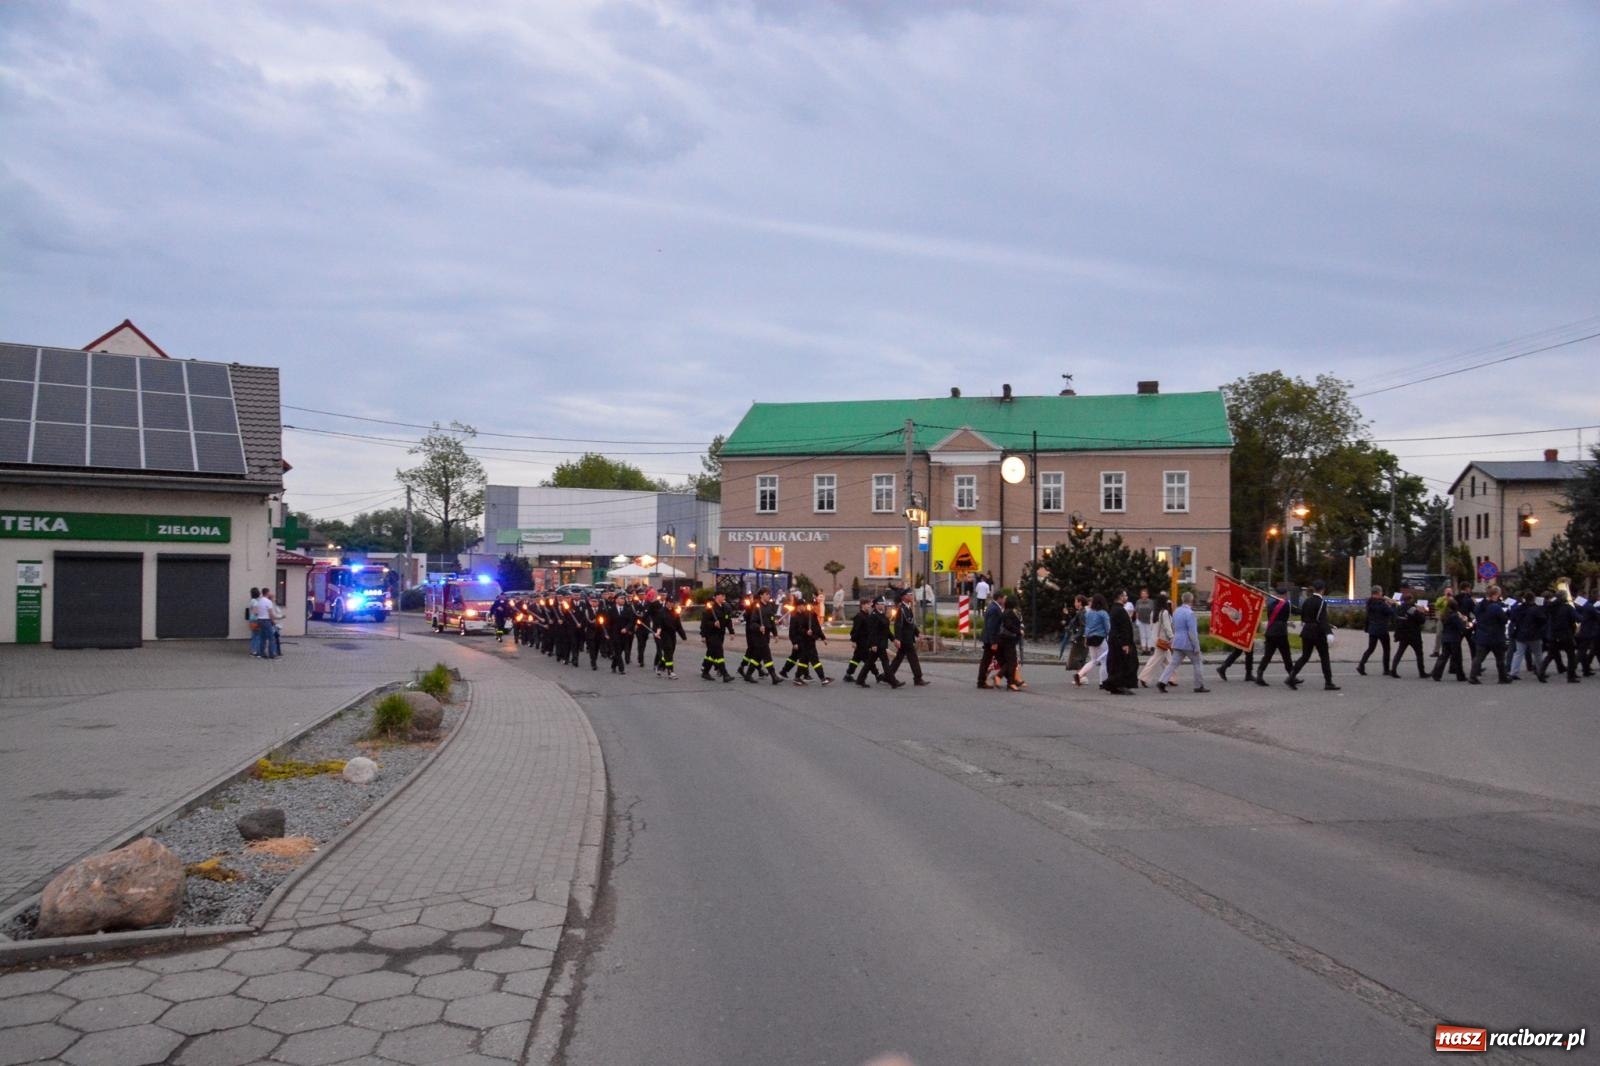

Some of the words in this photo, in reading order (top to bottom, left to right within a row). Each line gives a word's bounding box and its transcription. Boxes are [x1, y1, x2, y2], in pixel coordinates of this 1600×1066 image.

[1, 516, 69, 531] TEKA
[158, 525, 221, 535] ZIELONA
[728, 531, 822, 542] RESTAURACJA
